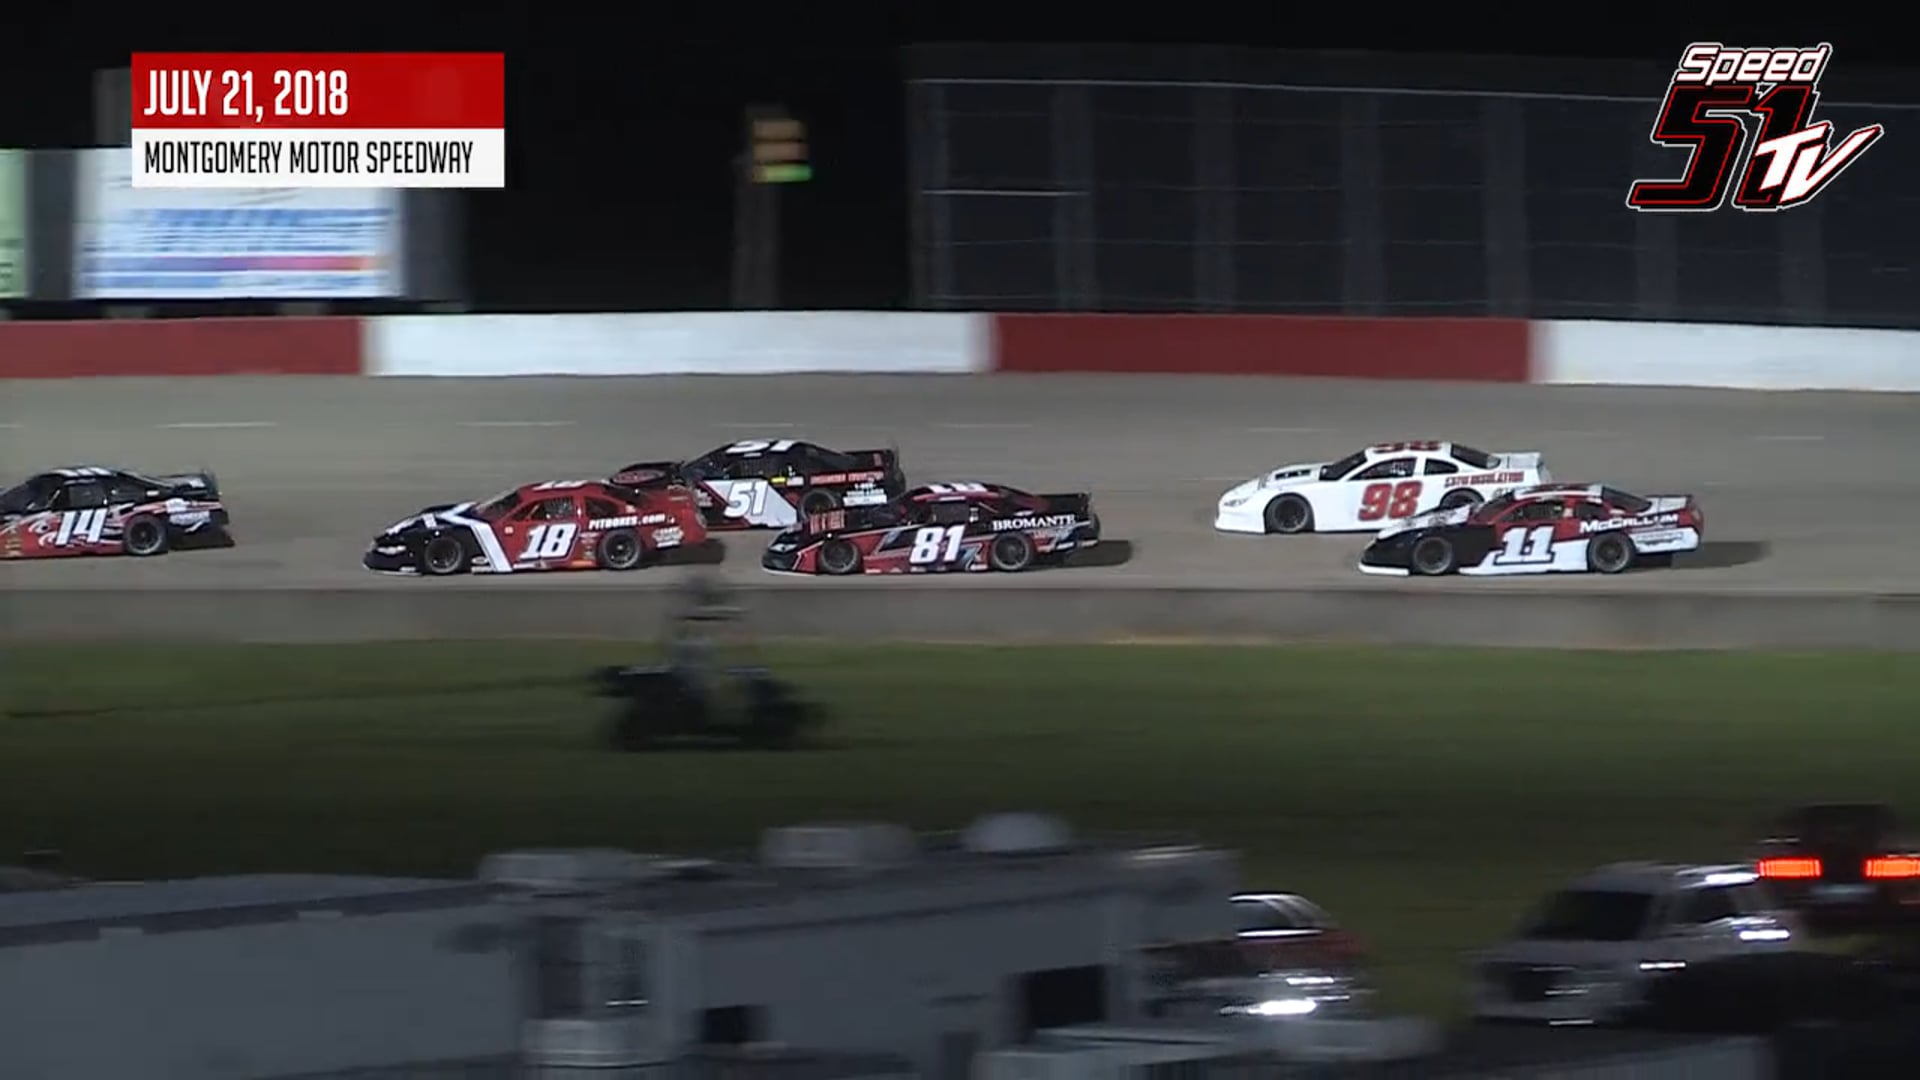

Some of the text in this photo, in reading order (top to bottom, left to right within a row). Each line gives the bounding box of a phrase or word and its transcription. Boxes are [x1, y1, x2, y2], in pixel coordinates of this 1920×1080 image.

[723, 480, 768, 518] 51
[1358, 481, 1423, 521] 98
[55, 508, 109, 546] 14
[519, 522, 579, 561] 18
[992, 514, 1076, 532] BROMANTE
[909, 525, 966, 564] 81
[1493, 525, 1556, 566] 11
